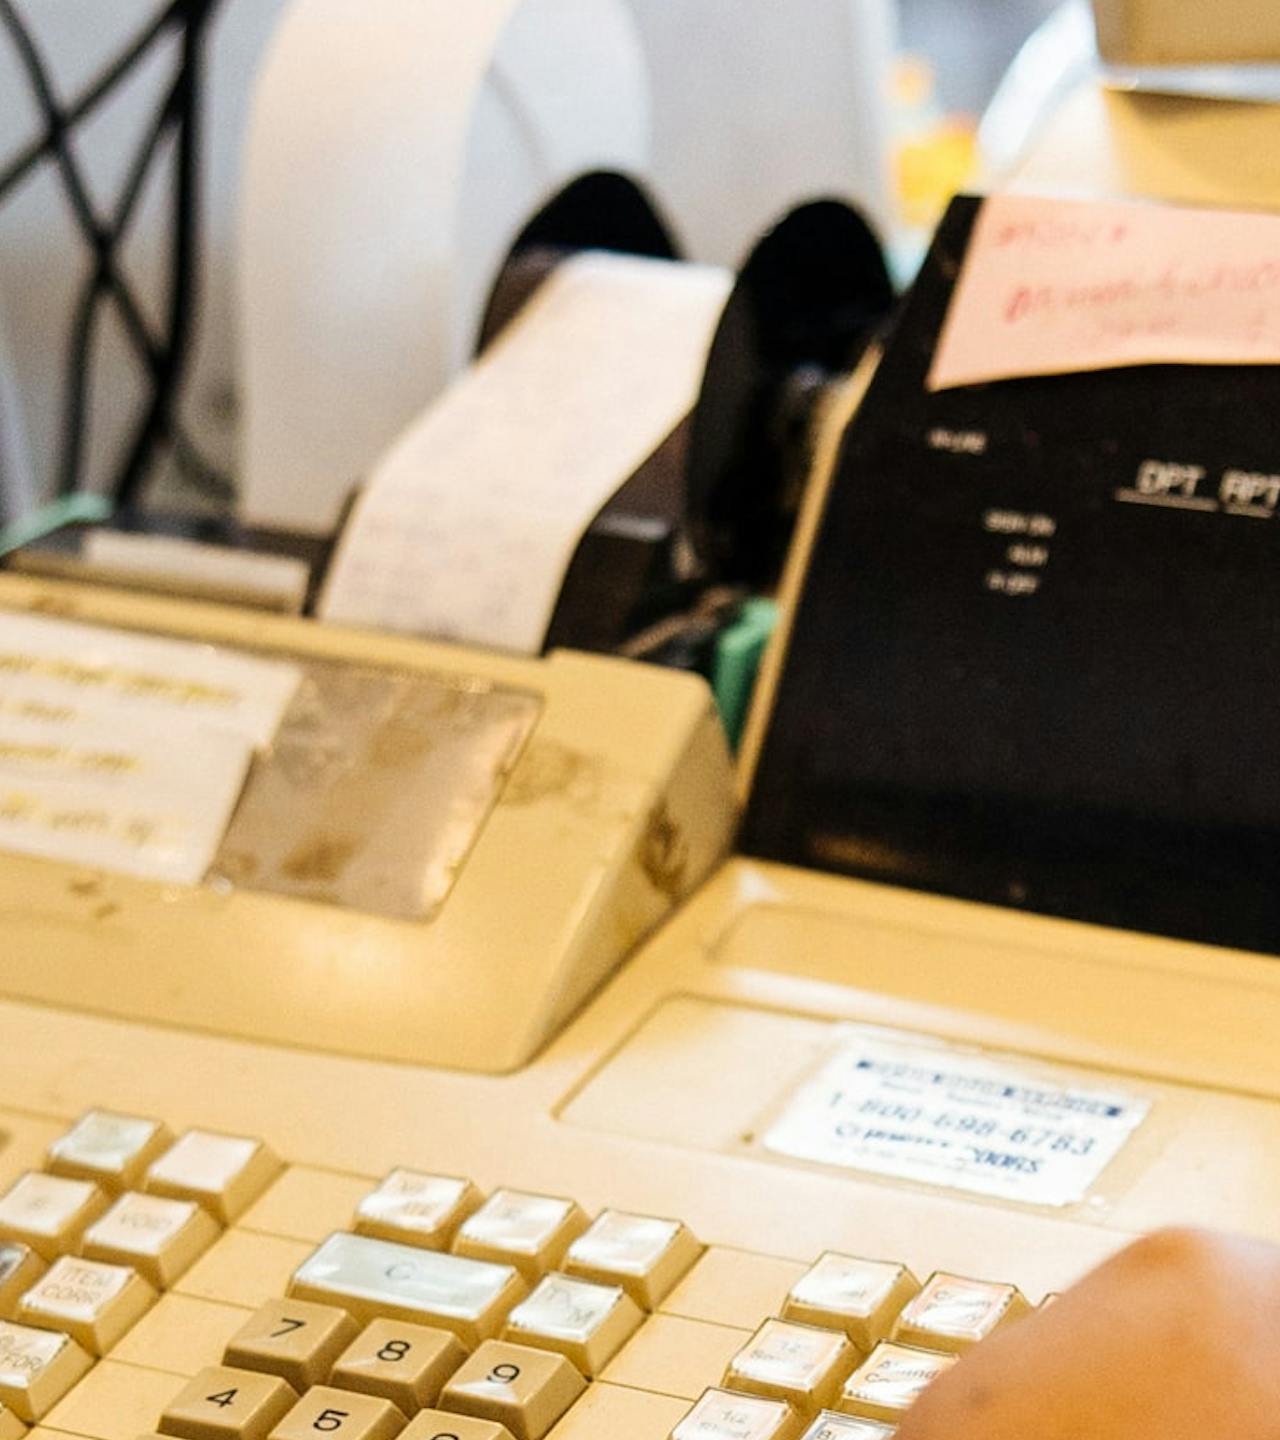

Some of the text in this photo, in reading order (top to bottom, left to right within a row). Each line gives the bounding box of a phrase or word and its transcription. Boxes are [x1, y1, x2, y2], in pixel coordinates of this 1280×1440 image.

[1136, 459, 1205, 496] DPT
[270, 1317, 307, 1338] 7
[376, 1340, 411, 1362] 8
[486, 1362, 521, 1385] 9
[207, 1387, 240, 1409] 4
[312, 1409, 350, 1432] 5
